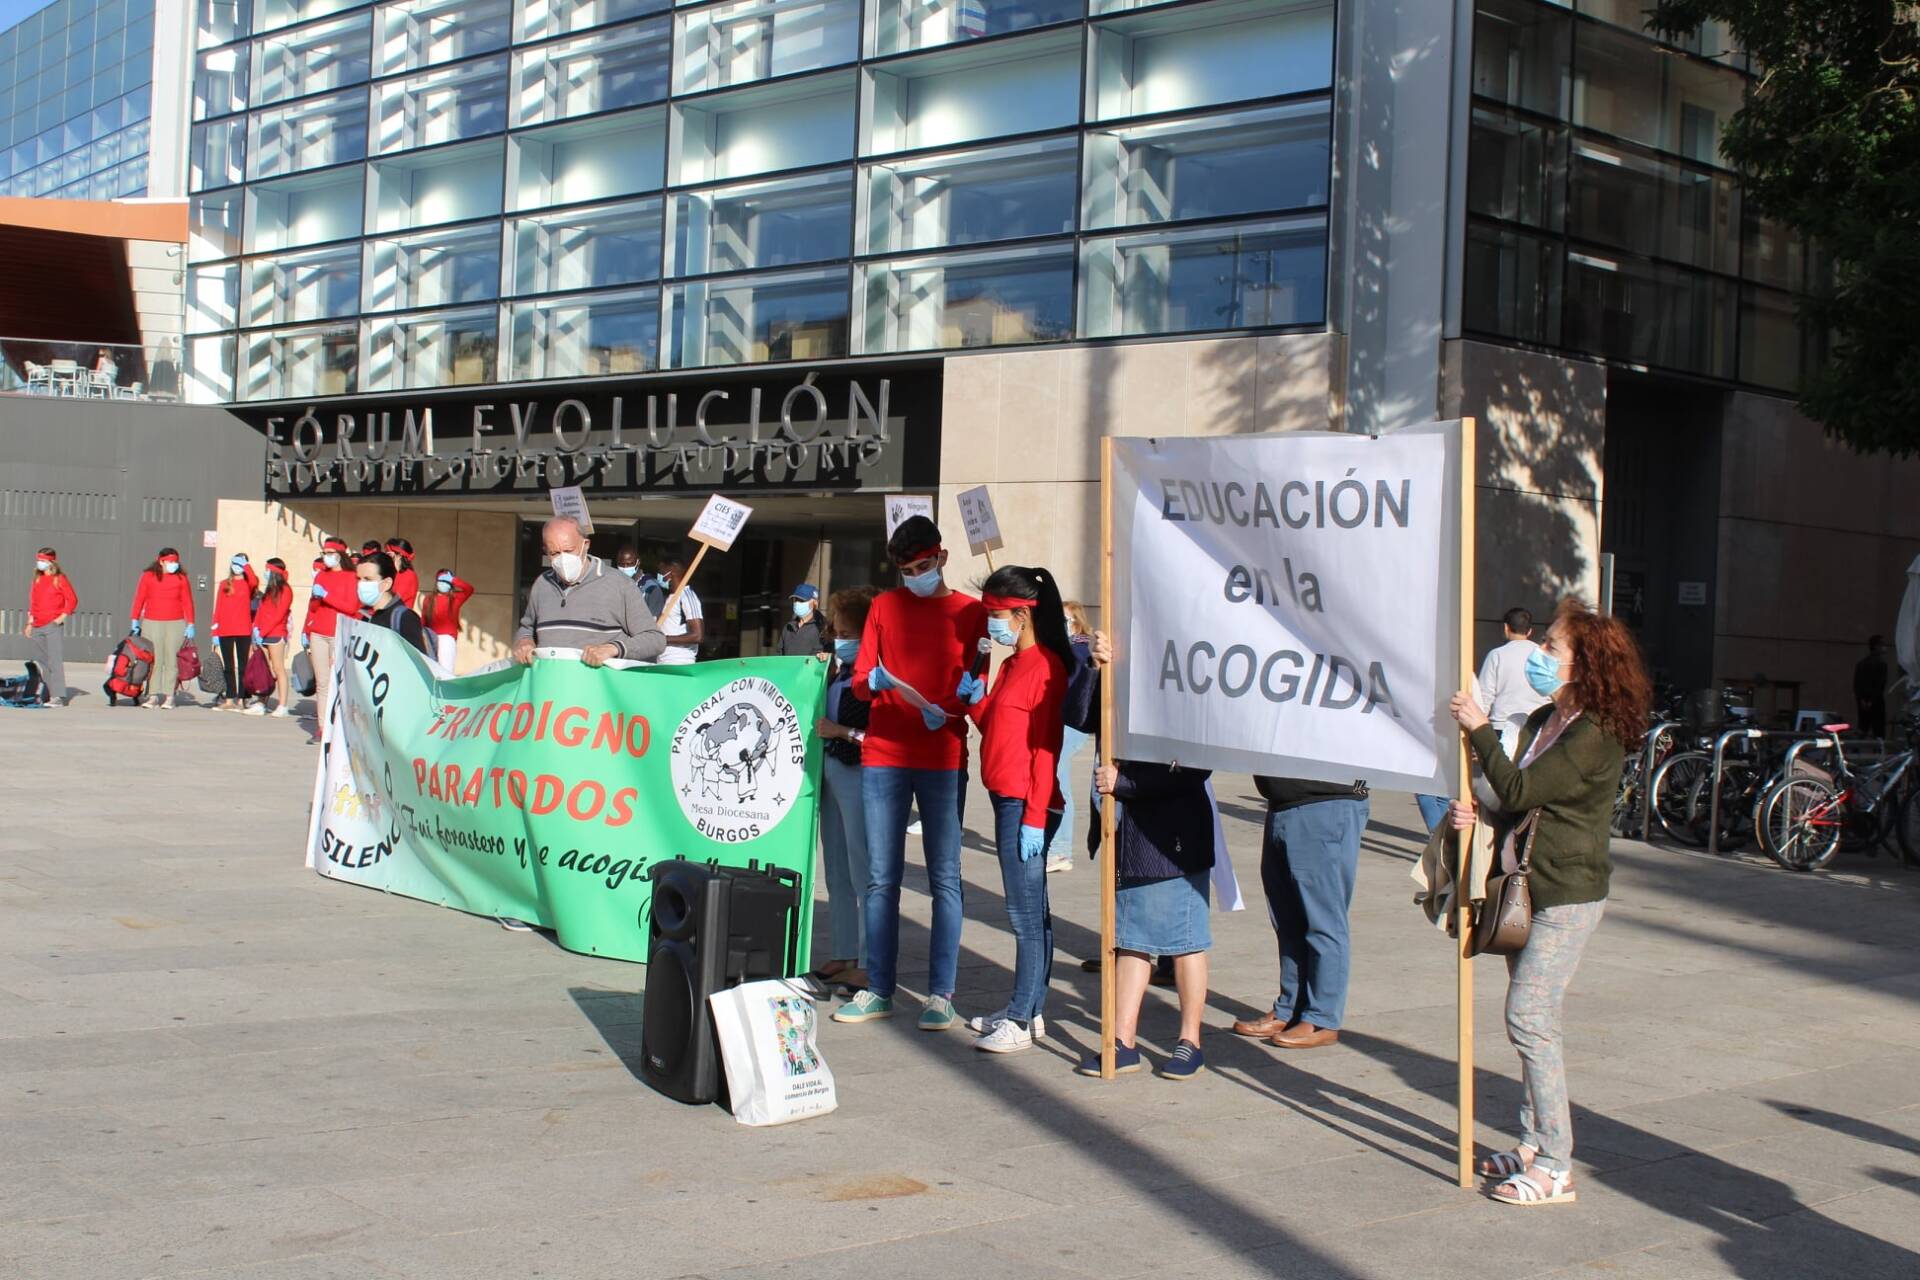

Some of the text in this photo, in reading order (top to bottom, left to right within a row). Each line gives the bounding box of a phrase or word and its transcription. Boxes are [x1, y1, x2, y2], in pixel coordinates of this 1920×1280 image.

[265, 371, 891, 462] FÓRUM EVOLUCIÓN
[382, 455, 413, 481] DE
[427, 447, 614, 481] CONGRESOS
[671, 437, 883, 473] AUDITORIO
[1159, 467, 1411, 530] EDUCACIÓN
[1223, 557, 1324, 613] en la
[1158, 639, 1402, 718] ACOGIDA
[508, 700, 651, 759] DIGNO
[671, 678, 804, 766] PASTORAL CON INMIGRANTES
[412, 757, 639, 828] PARA TODOS
[691, 802, 770, 822] Mesa Diocesana
[435, 813, 505, 857] forastero
[696, 817, 761, 842] BURGOS
